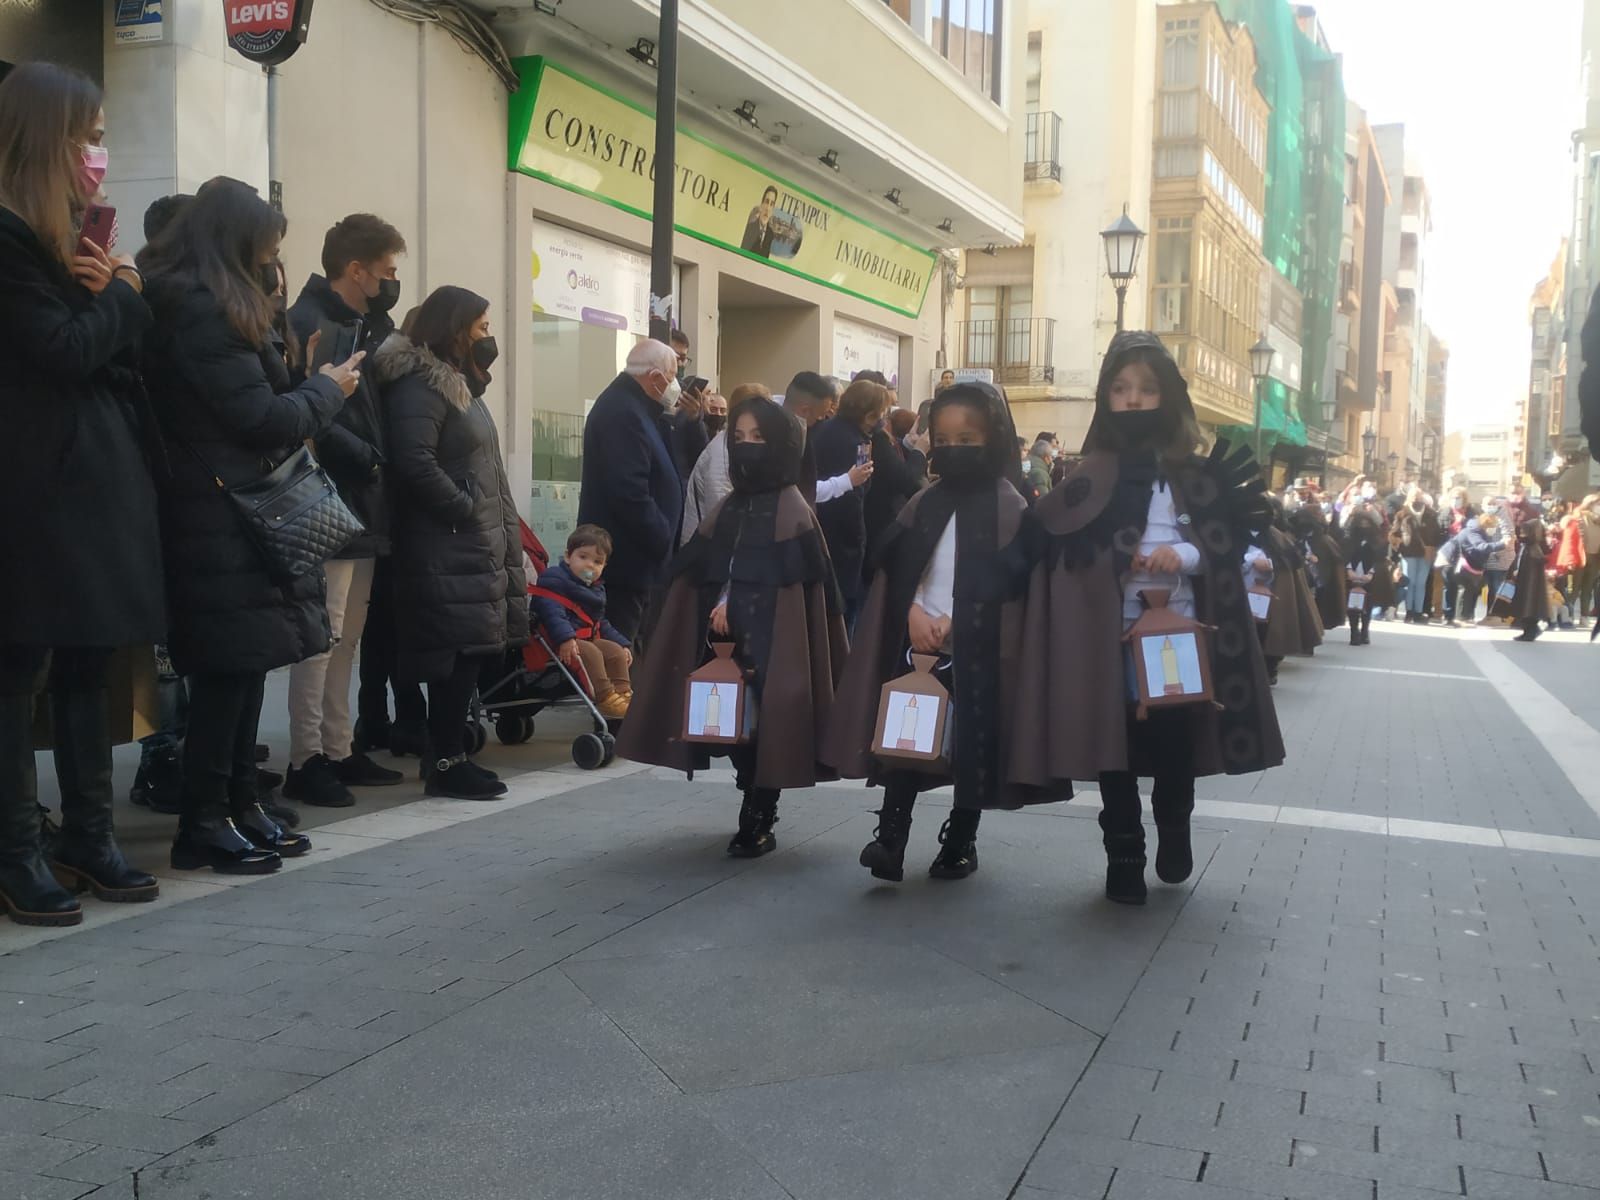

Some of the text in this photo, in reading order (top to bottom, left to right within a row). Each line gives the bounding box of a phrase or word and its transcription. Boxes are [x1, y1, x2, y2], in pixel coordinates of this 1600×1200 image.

[545, 108, 730, 212] CONSTRTORA
[578, 273, 600, 291] aldro
[836, 240, 922, 293] INMOBILIARIA
